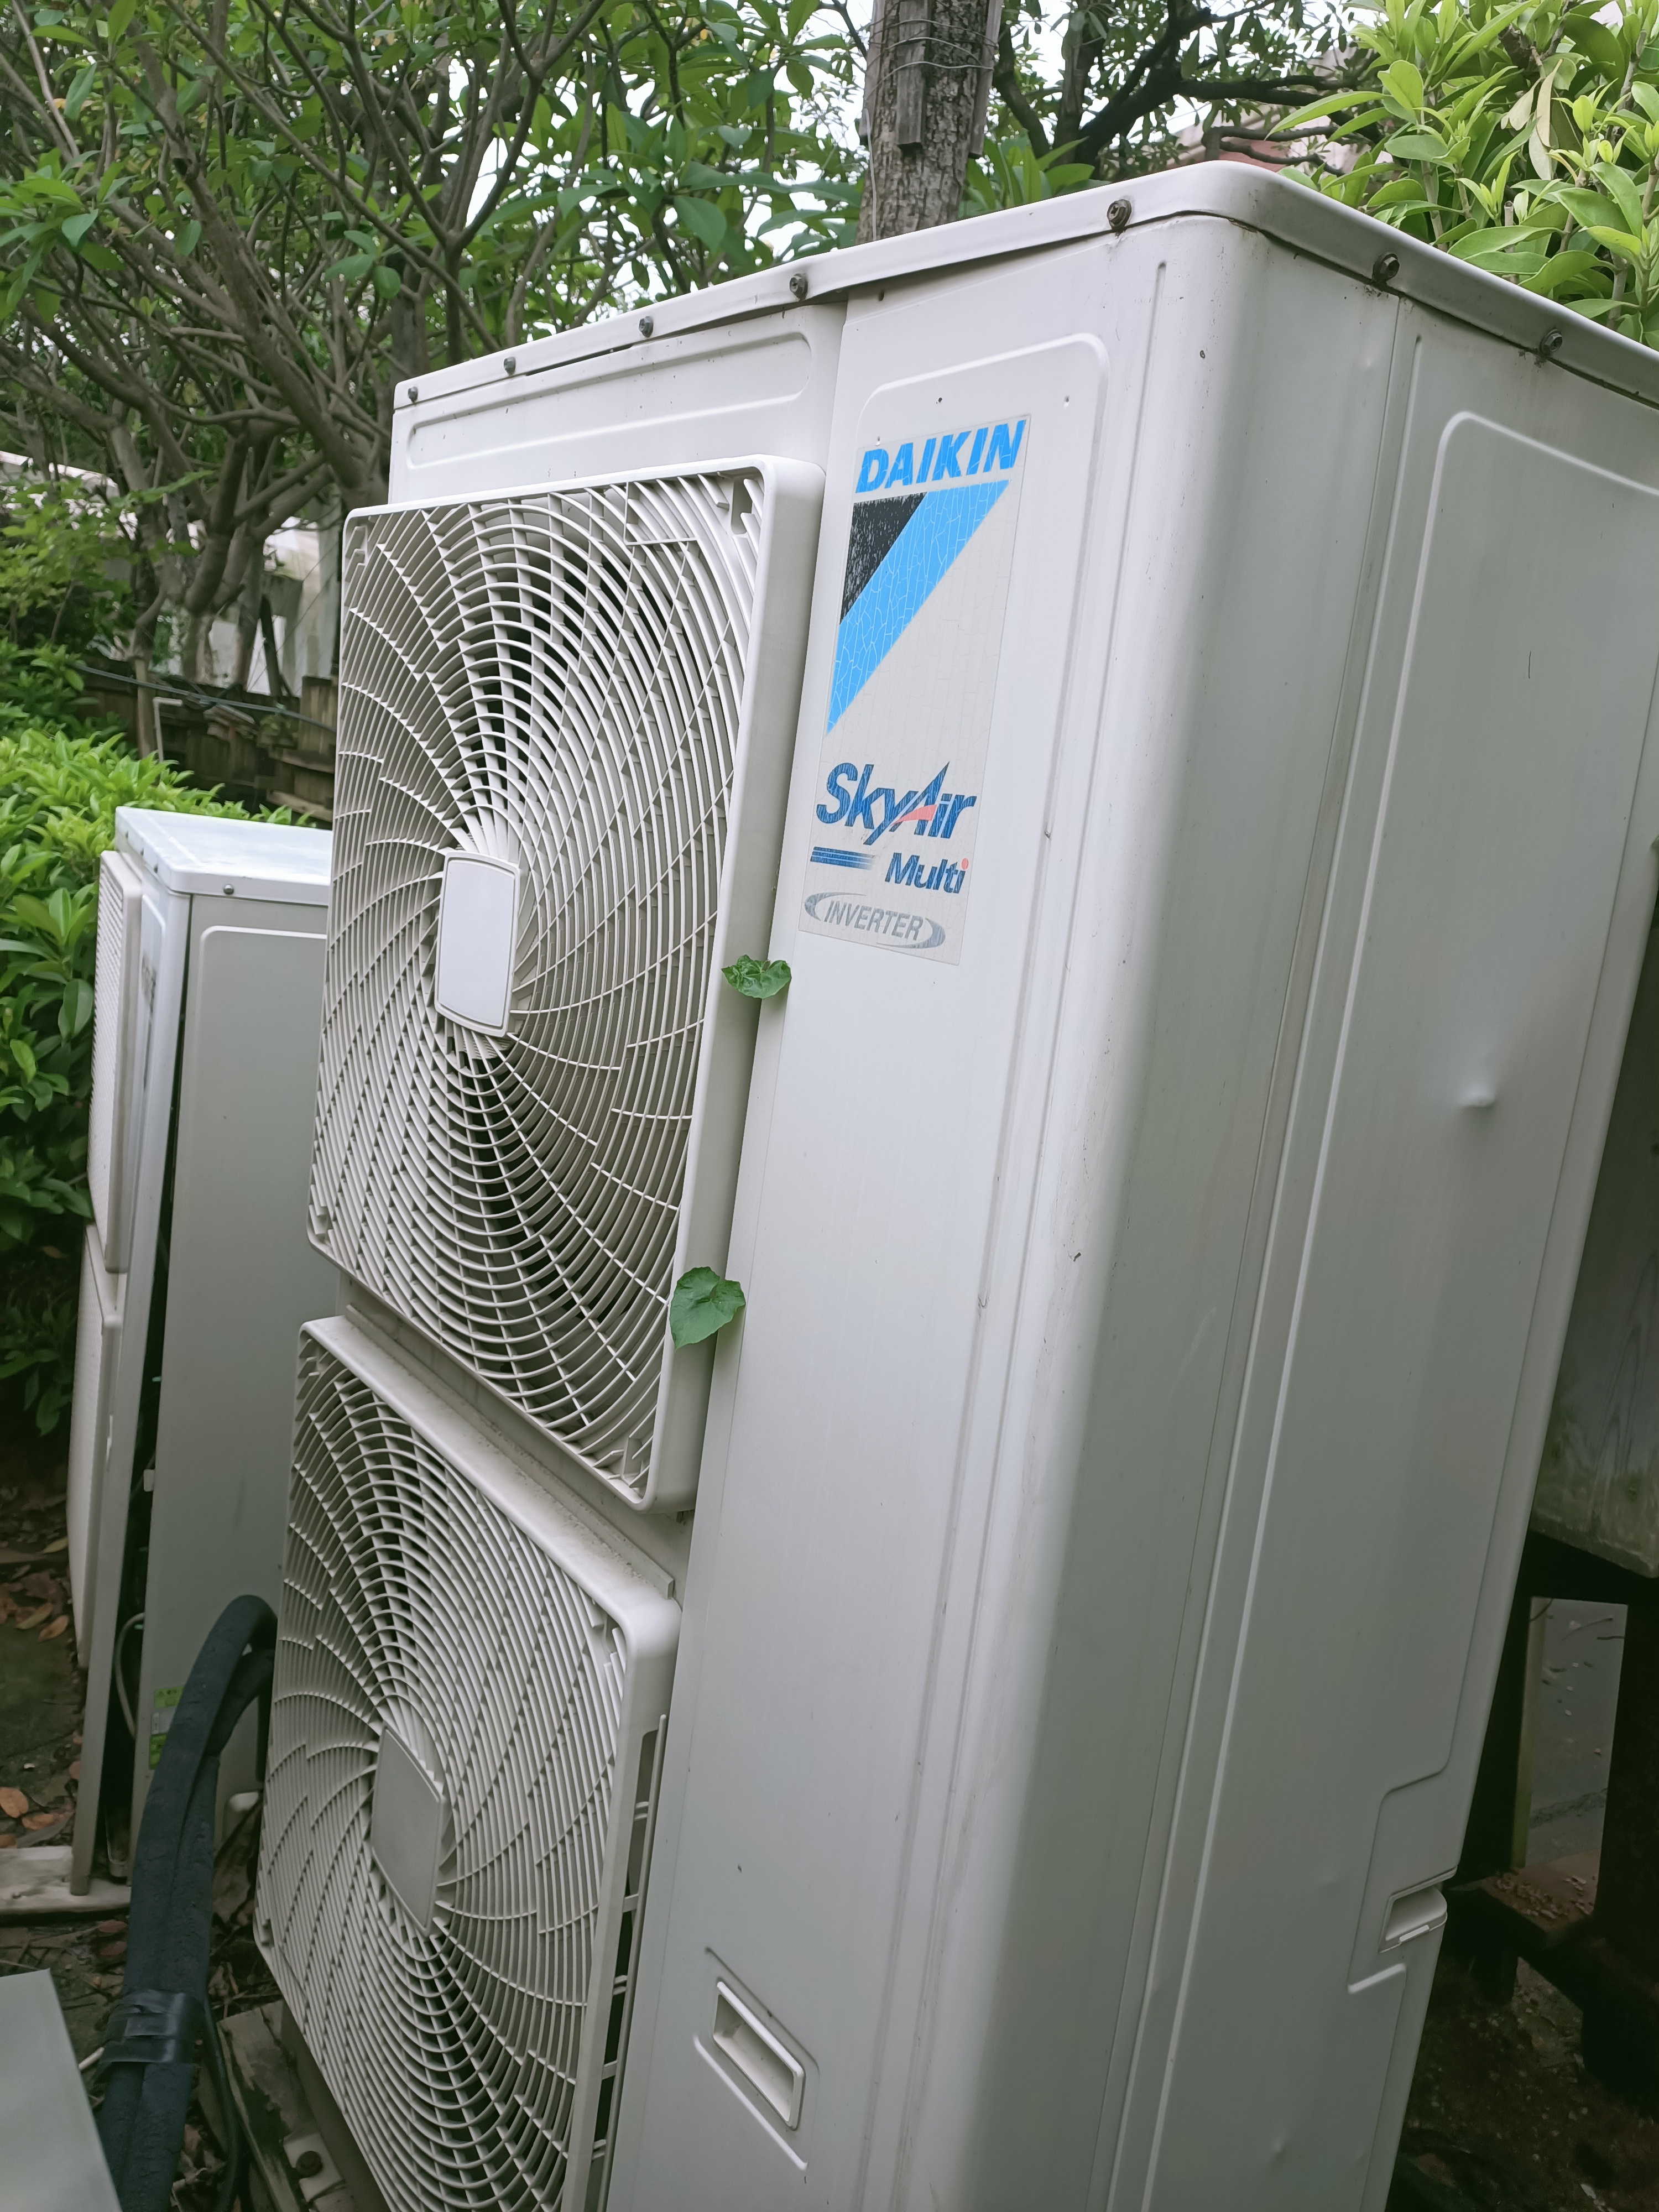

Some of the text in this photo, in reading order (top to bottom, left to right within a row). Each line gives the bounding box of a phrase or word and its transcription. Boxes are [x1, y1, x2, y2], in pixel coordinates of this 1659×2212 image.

[855, 419, 1027, 494] DAIKIN
[885, 852, 969, 894] Multi
[824, 900, 924, 941] INVERTER
